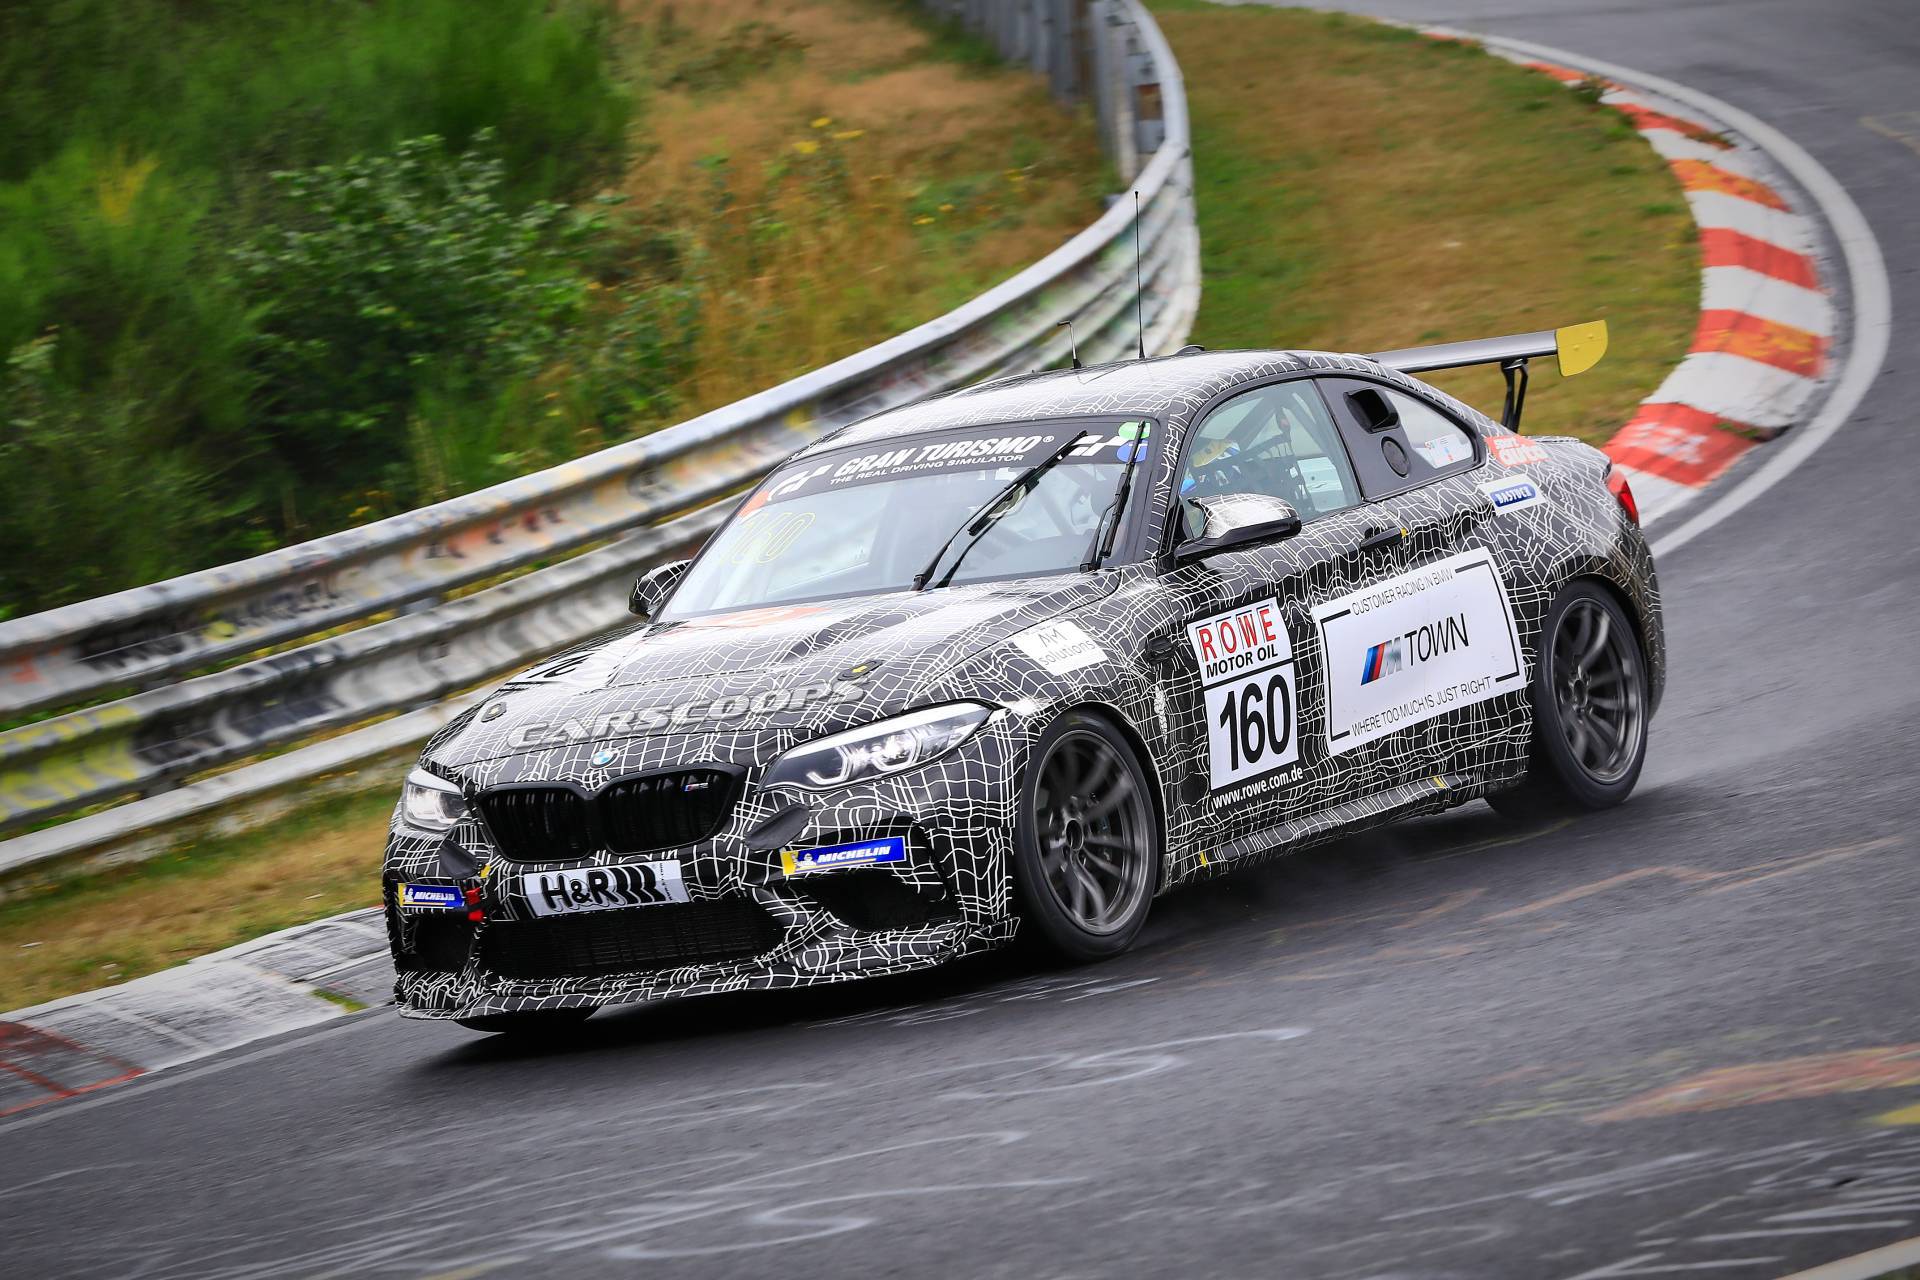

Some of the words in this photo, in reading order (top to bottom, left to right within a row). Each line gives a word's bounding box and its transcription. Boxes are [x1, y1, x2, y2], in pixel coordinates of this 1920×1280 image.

[829, 475, 853, 485] THE
[856, 469, 888, 480] REAL
[890, 461, 945, 474] DRIVING
[946, 454, 1025, 466] SIMULATOR
[833, 448, 917, 477] GRAN
[1351, 588, 1397, 616] CUSTOMER
[1395, 577, 1426, 599] RACING
[1432, 567, 1454, 586] BMW
[1038, 640, 1096, 666] solutions
[1197, 607, 1277, 662] ROWE
[1404, 612, 1470, 667] TOWN
[1206, 651, 1254, 679] MOTOR
[1257, 643, 1279, 662] OIL
[507, 682, 867, 749] CARSCOOPS
[1219, 673, 1291, 772] 160
[1351, 714, 1382, 737] WHERE
[1381, 707, 1400, 725] TOO
[1399, 698, 1426, 719] MUCH
[1424, 694, 1436, 710] IS
[1436, 685, 1458, 706] JUST
[1461, 675, 1492, 698] RIGHT
[1212, 764, 1304, 810] www.rowe.com.de
[816, 845, 892, 864] MICHELIN
[413, 891, 456, 902] MICHELIN
[540, 865, 656, 912] H&R
